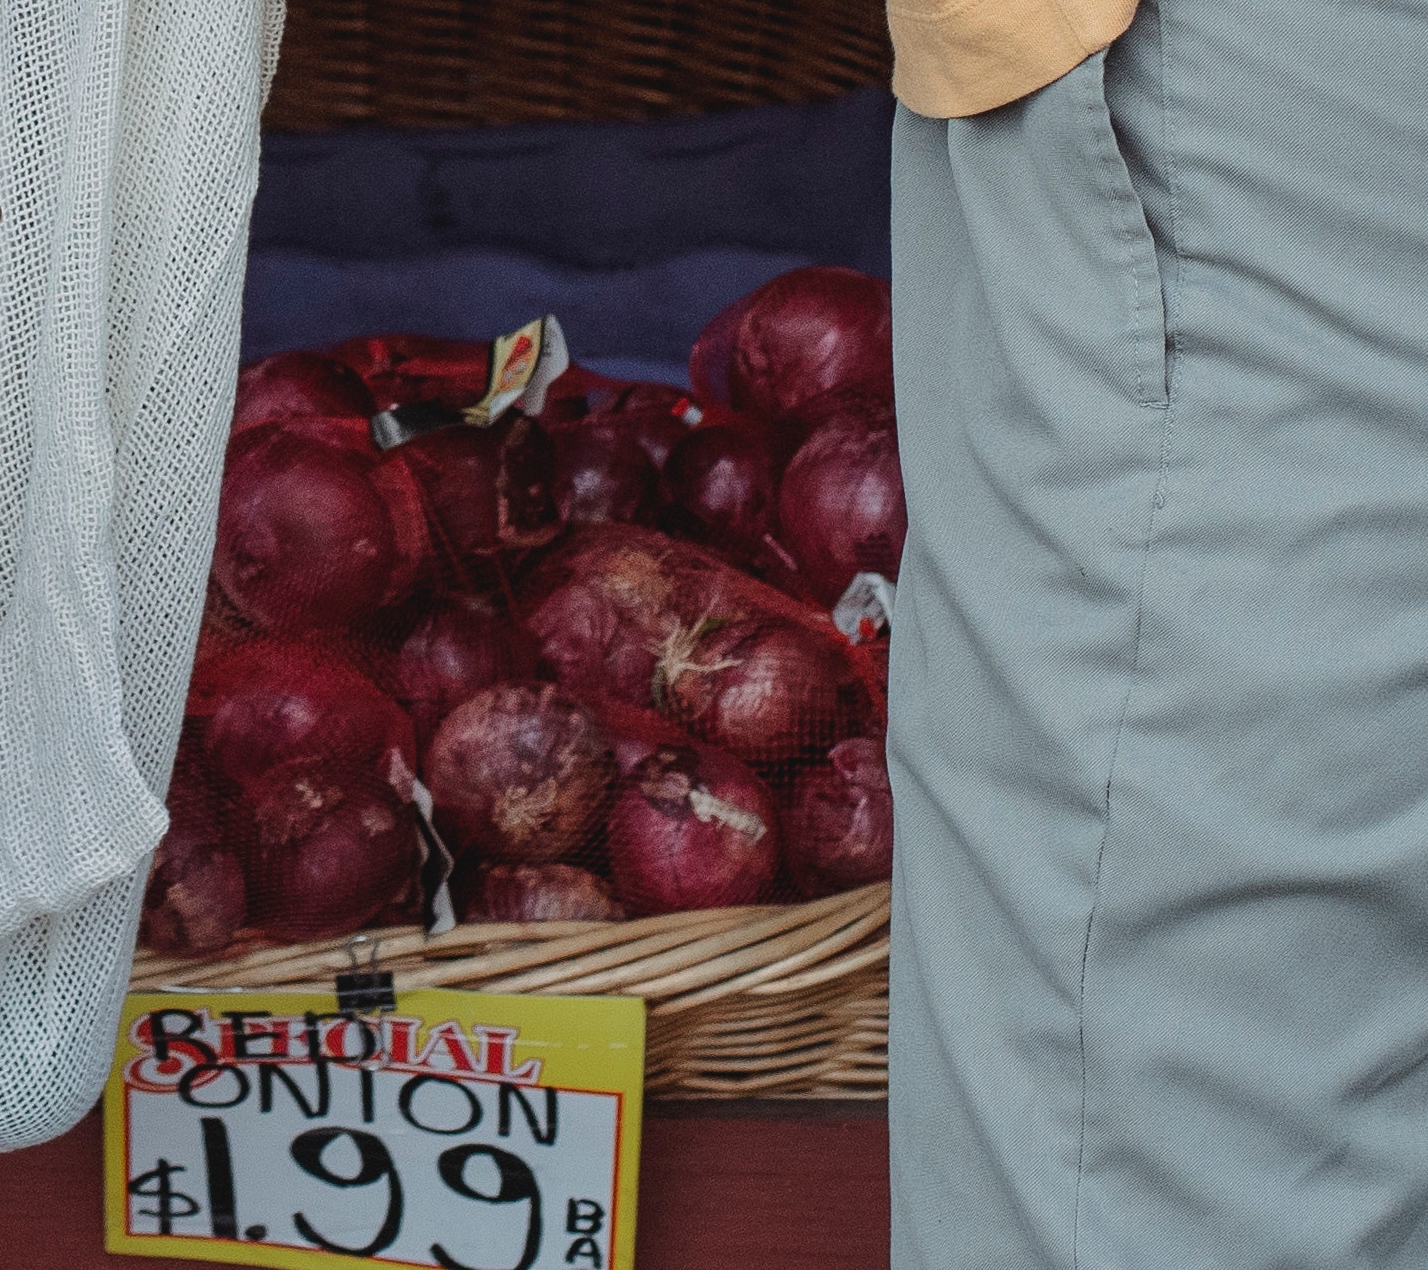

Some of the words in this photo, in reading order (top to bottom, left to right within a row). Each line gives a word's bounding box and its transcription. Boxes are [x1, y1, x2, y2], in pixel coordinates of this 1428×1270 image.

[178, 1061, 560, 1147] ONION
[128, 1116, 544, 1270] $1.99
[564, 1197, 605, 1270] BA
